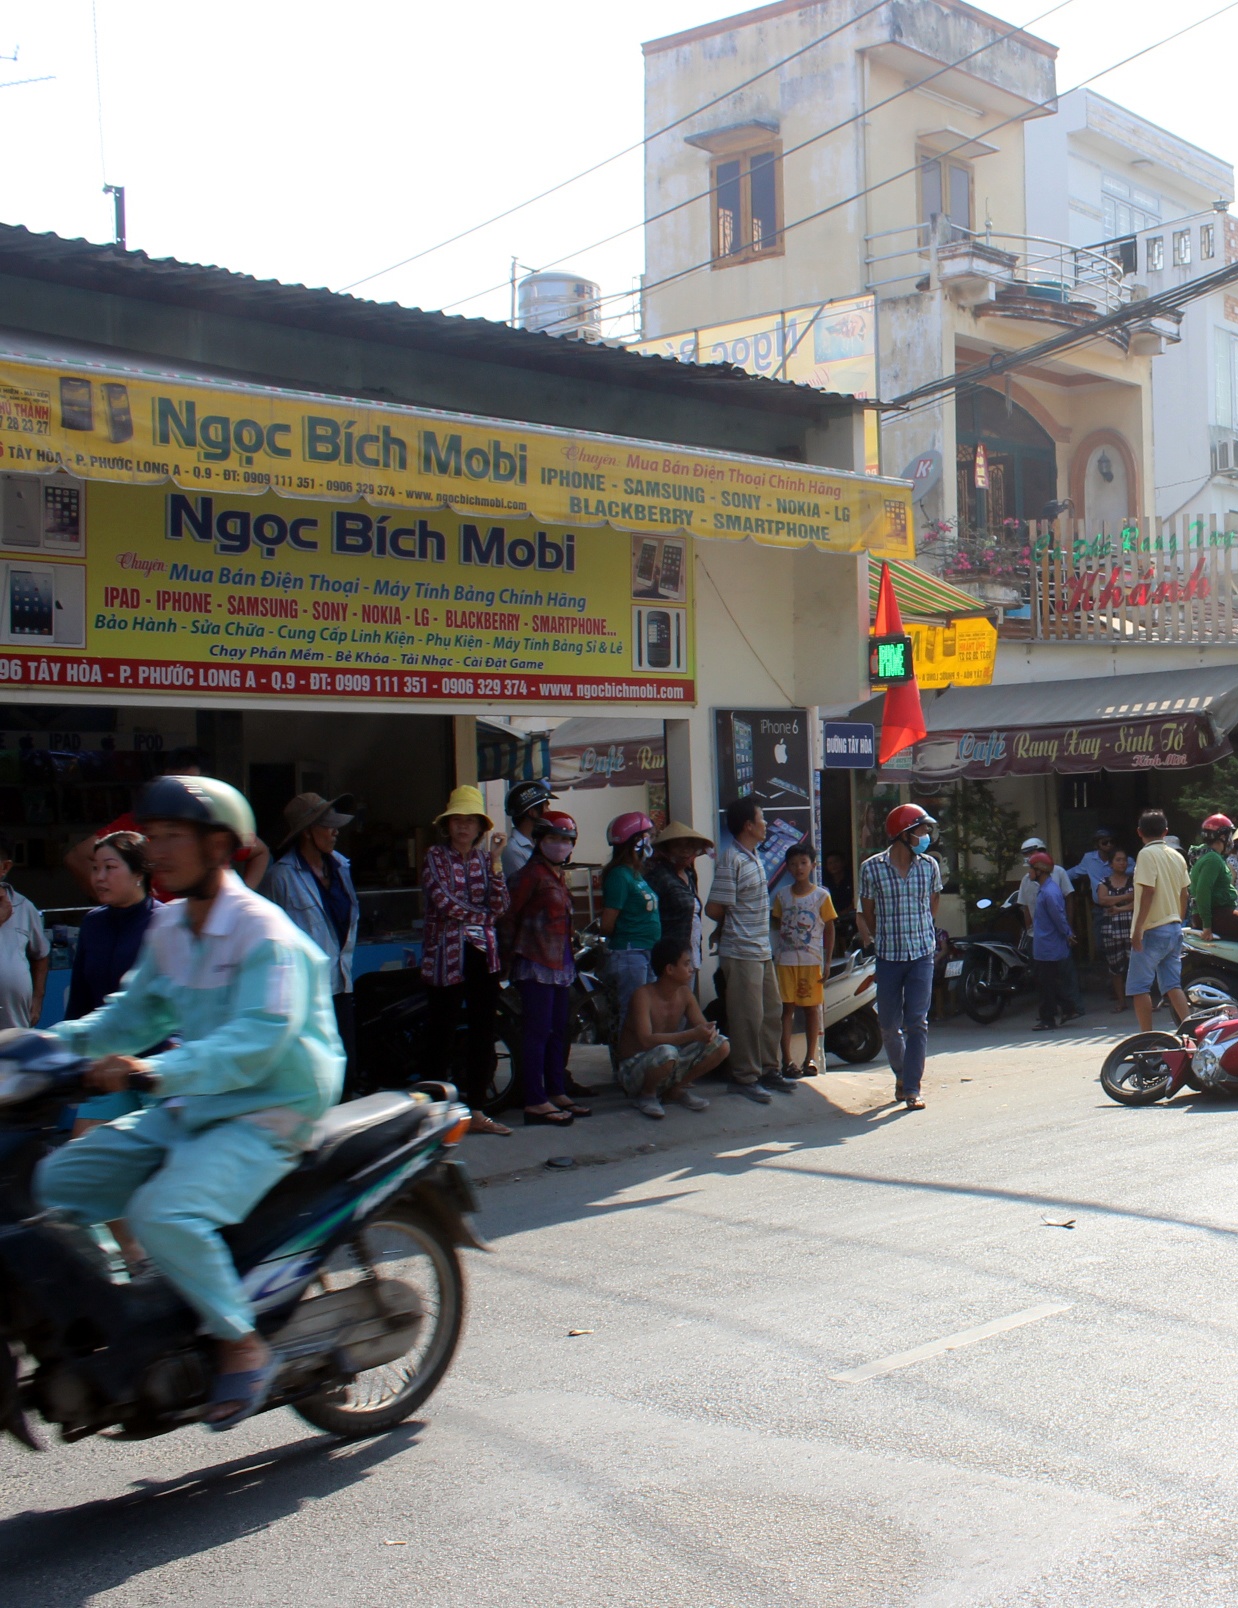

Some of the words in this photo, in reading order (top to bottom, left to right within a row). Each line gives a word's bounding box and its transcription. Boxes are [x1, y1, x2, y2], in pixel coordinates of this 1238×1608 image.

[152, 396, 292, 466] Ngọc
[303, 415, 407, 471] Bích
[419, 430, 527, 486] Mobi
[541, 467, 606, 492] IPHONE
[623, 478, 705, 503] SAMSUNG
[721, 490, 761, 511] SONY
[776, 497, 821, 518] NOKIA
[835, 507, 851, 522] LG
[626, 454, 659, 472] Mua
[662, 458, 689, 476] Bán
[693, 463, 724, 484] Điện
[728, 468, 765, 490] Thoại
[769, 474, 805, 493] Chính
[808, 480, 842, 500] Hãng
[165, 492, 320, 560] Ngọc
[332, 510, 446, 562] Bích
[459, 523, 576, 573] Mobi
[569, 496, 694, 526] BLACKBERRY
[713, 513, 831, 541] SMARTPHONE
[1120, 526, 1178, 560] Rang
[116, 552, 168, 577] Chuyên:
[169, 563, 214, 584] Mua
[218, 566, 256, 586] Bán
[260, 570, 304, 594] Điện
[309, 574, 359, 598] Thoại
[373, 579, 410, 601] Máy
[414, 580, 450, 600] Tính
[454, 584, 495, 607] Bảng
[499, 588, 543, 607] Chính
[547, 592, 587, 613] Hãng
[1056, 557, 1212, 614] Khánh
[94, 613, 128, 631] Bảo
[132, 616, 177, 633] Hành
[190, 617, 220, 636] Sửa
[225, 620, 265, 638] Chữa
[277, 624, 316, 644] Cung
[320, 624, 348, 644] Cấp
[351, 628, 382, 644] Linh
[384, 630, 415, 649] Kiện
[425, 632, 451, 649] Phụ
[454, 633, 483, 650] Kiện
[493, 635, 520, 653] Máy
[523, 637, 549, 652] Tính
[552, 639, 583, 656] Bảng
[104, 587, 140, 609] IPAD
[156, 590, 212, 614] IPHONE
[227, 594, 299, 619] SAMSUNG
[312, 600, 348, 622] SONY
[361, 604, 402, 626] NOKIA
[414, 607, 430, 627] LG
[446, 609, 521, 632] BLACKBERRY
[532, 614, 617, 637] SMARTPHONE...
[28, 659, 61, 683] TÂY
[66, 659, 103, 683] HÒA
[119, 664, 134, 684] P.
[138, 663, 194, 686] PHƯỚC
[199, 668, 241, 687] LONG
[245, 670, 256, 688] A
[271, 671, 296, 690] Q.9
[310, 673, 331, 691] ĐT:
[335, 673, 370, 692] 0909
[374, 675, 398, 693] 111
[403, 676, 427, 694] 351
[441, 677, 473, 695] 0906
[477, 678, 500, 696] 329
[504, 679, 527, 697] 374
[539, 682, 573, 698] www.
[576, 681, 684, 699] ngocbichmobi.com
[209, 643, 247, 660] Chạy
[250, 645, 286, 660] Phần
[290, 647, 324, 662] Mềm
[355, 651, 389, 664] Khóa
[400, 653, 420, 666] Tải
[421, 654, 453, 669] Nhạc
[463, 655, 483, 668] Cài
[485, 656, 507, 670] Đặt
[509, 657, 544, 670] Game
[49, 733, 82, 750] IPAD
[133, 733, 164, 751] IPOD
[760, 718, 791, 735] iPhone
[792, 718, 799, 735] 6
[826, 734, 847, 754] ĐƯỜNG
[848, 735, 859, 754] TÂY
[860, 734, 873, 754] HÒA
[958, 729, 1007, 767] Café
[1013, 731, 1057, 762] Rang
[1064, 728, 1101, 759] Xay
[1114, 722, 1154, 754] Sinh
[1160, 721, 1188, 752] Tố
[1130, 753, 1161, 767] Kính
[1162, 753, 1188, 767] Mời
